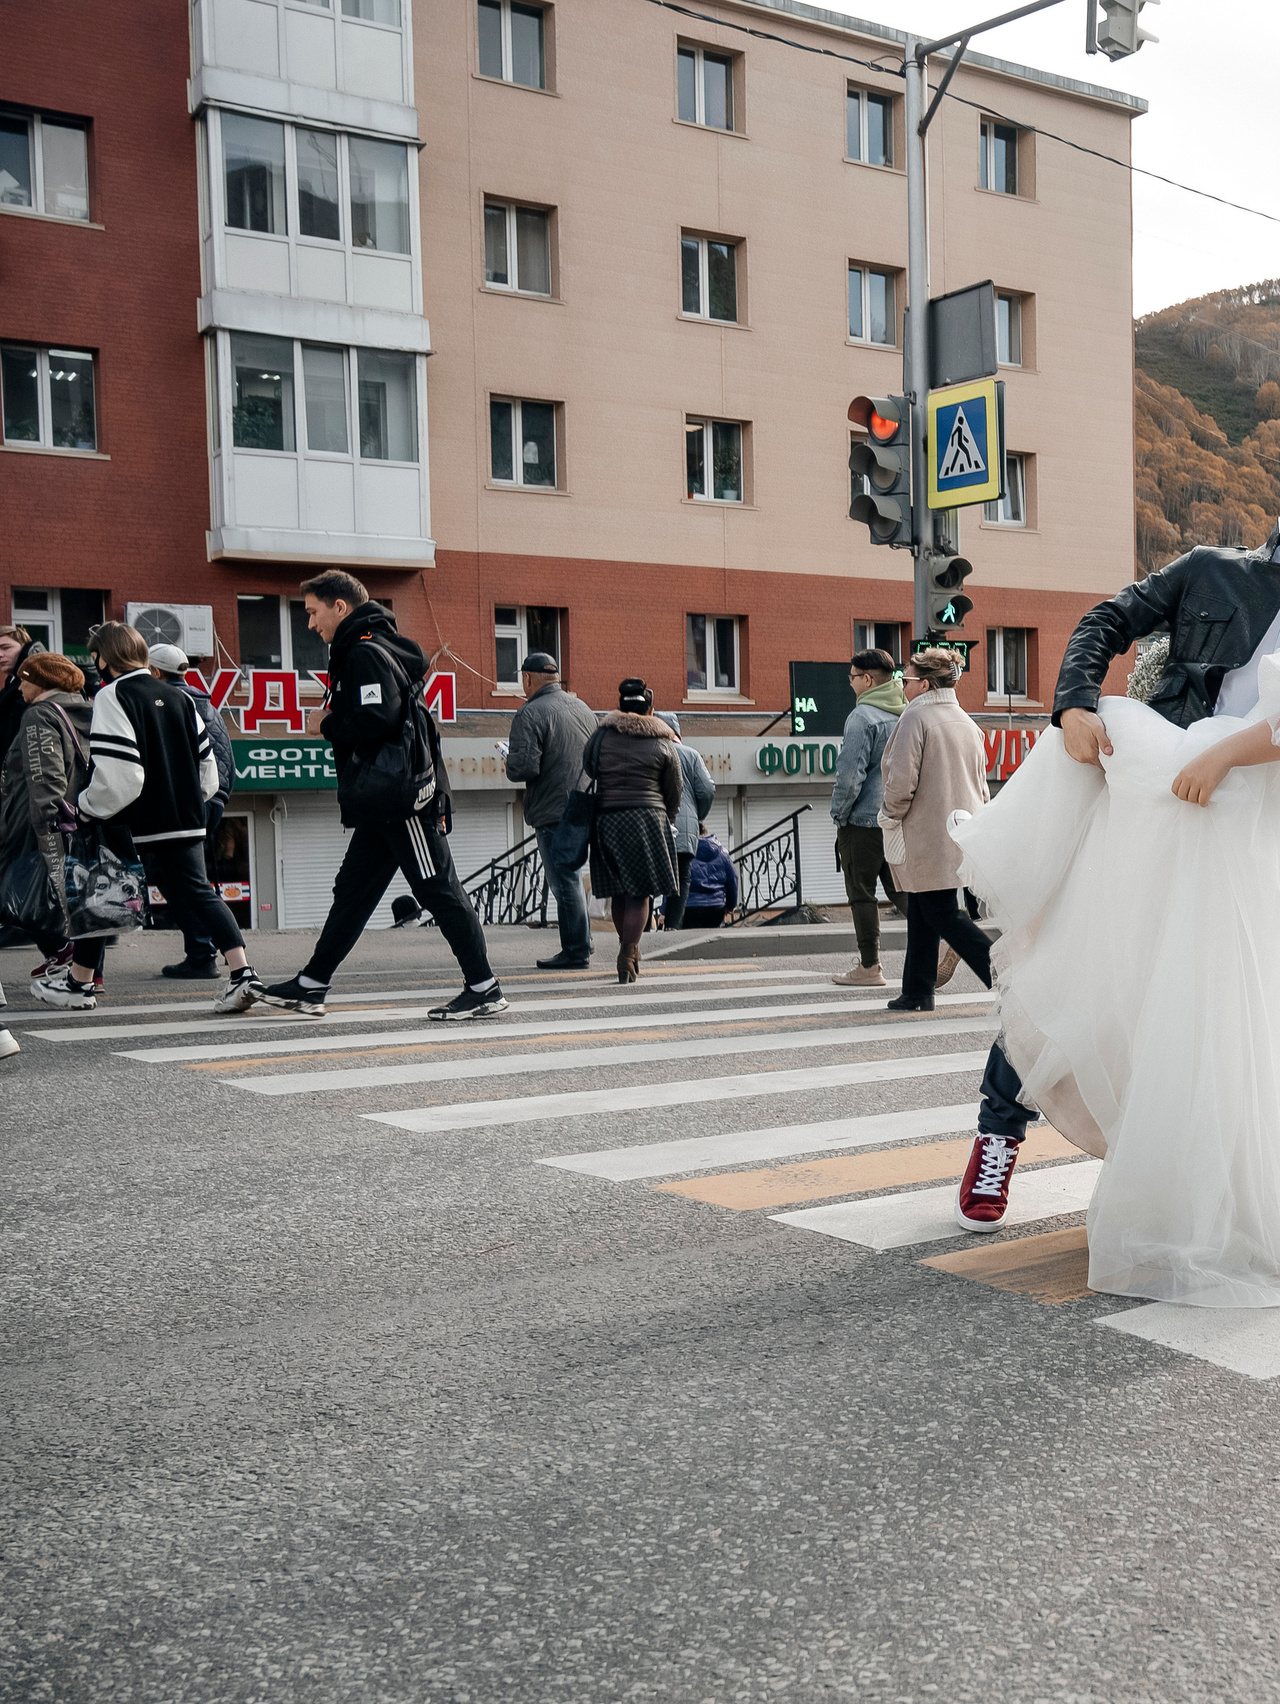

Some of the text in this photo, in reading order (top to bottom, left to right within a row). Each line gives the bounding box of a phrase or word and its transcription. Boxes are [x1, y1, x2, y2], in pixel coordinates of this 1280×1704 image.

[795, 697, 818, 713] НА
[26, 724, 43, 783] BEAUTIFU
[38, 727, 55, 755] AND
[418, 776, 436, 802] NIK
